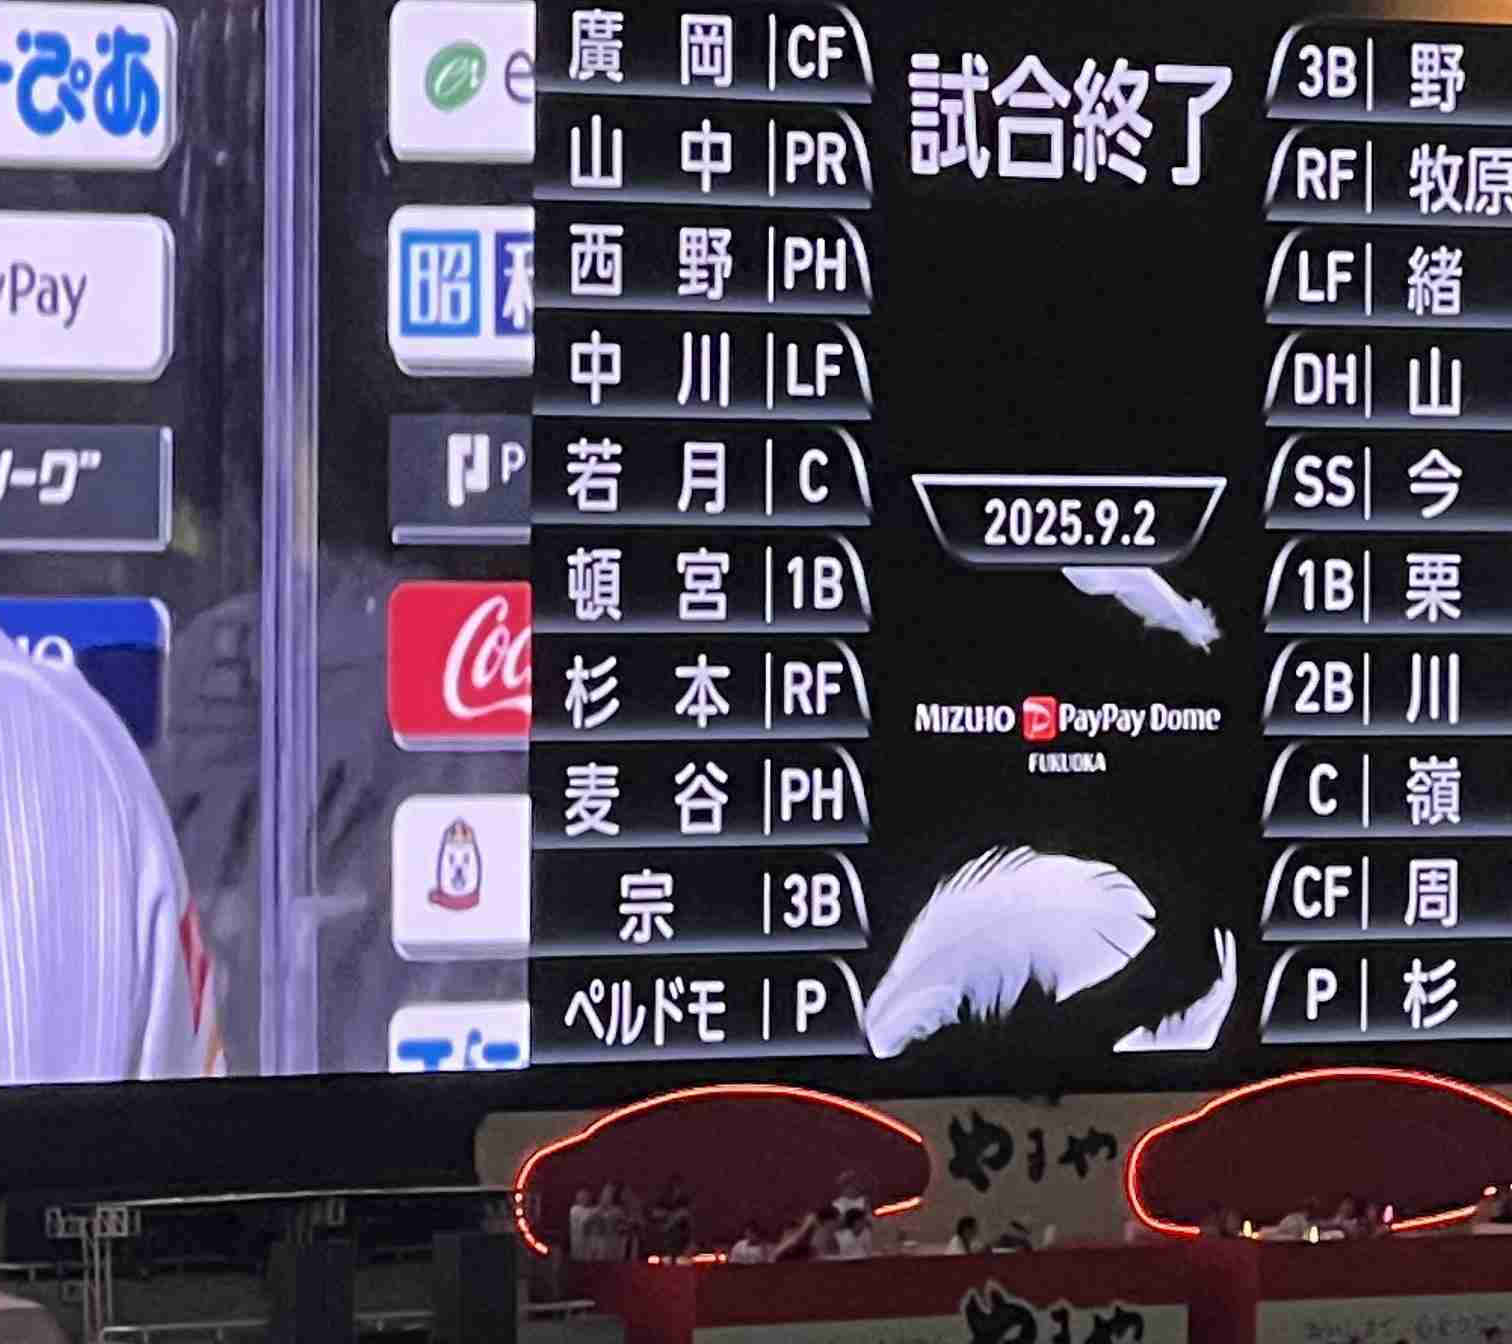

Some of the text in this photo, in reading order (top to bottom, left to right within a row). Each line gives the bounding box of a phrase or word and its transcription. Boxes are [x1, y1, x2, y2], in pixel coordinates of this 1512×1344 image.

[788, 24, 846, 79] CF
[1298, 43, 1465, 113] 3B 野
[908, 52, 1232, 186] 試合終了
[787, 131, 847, 185] PR
[1297, 143, 1512, 215] RF 牧原
[784, 236, 846, 291] PH
[1298, 246, 1463, 316] LF 緒
[787, 343, 843, 396] LF
[1294, 347, 1461, 416] DH 山
[799, 449, 828, 503] C
[1294, 449, 1462, 519] SS 今
[984, 498, 1156, 546] 2025.9.2
[787, 556, 843, 609] 1B
[1298, 553, 1461, 623] 1B 栗
[784, 661, 843, 715] RF
[1295, 653, 1459, 725] 2B 川
[915, 703, 1016, 733] MIZUHO
[1059, 703, 1146, 738] PayPay
[1150, 703, 1221, 731] Dome
[1028, 752, 1106, 773] FUKUOKA
[1309, 763, 1338, 815] C
[781, 768, 843, 821] PH
[619, 868, 841, 943] 宗 3B
[1293, 859, 1458, 927] CF 周
[564, 976, 827, 1046] ペルドモ P
[1307, 958, 1458, 1030] P 杉
